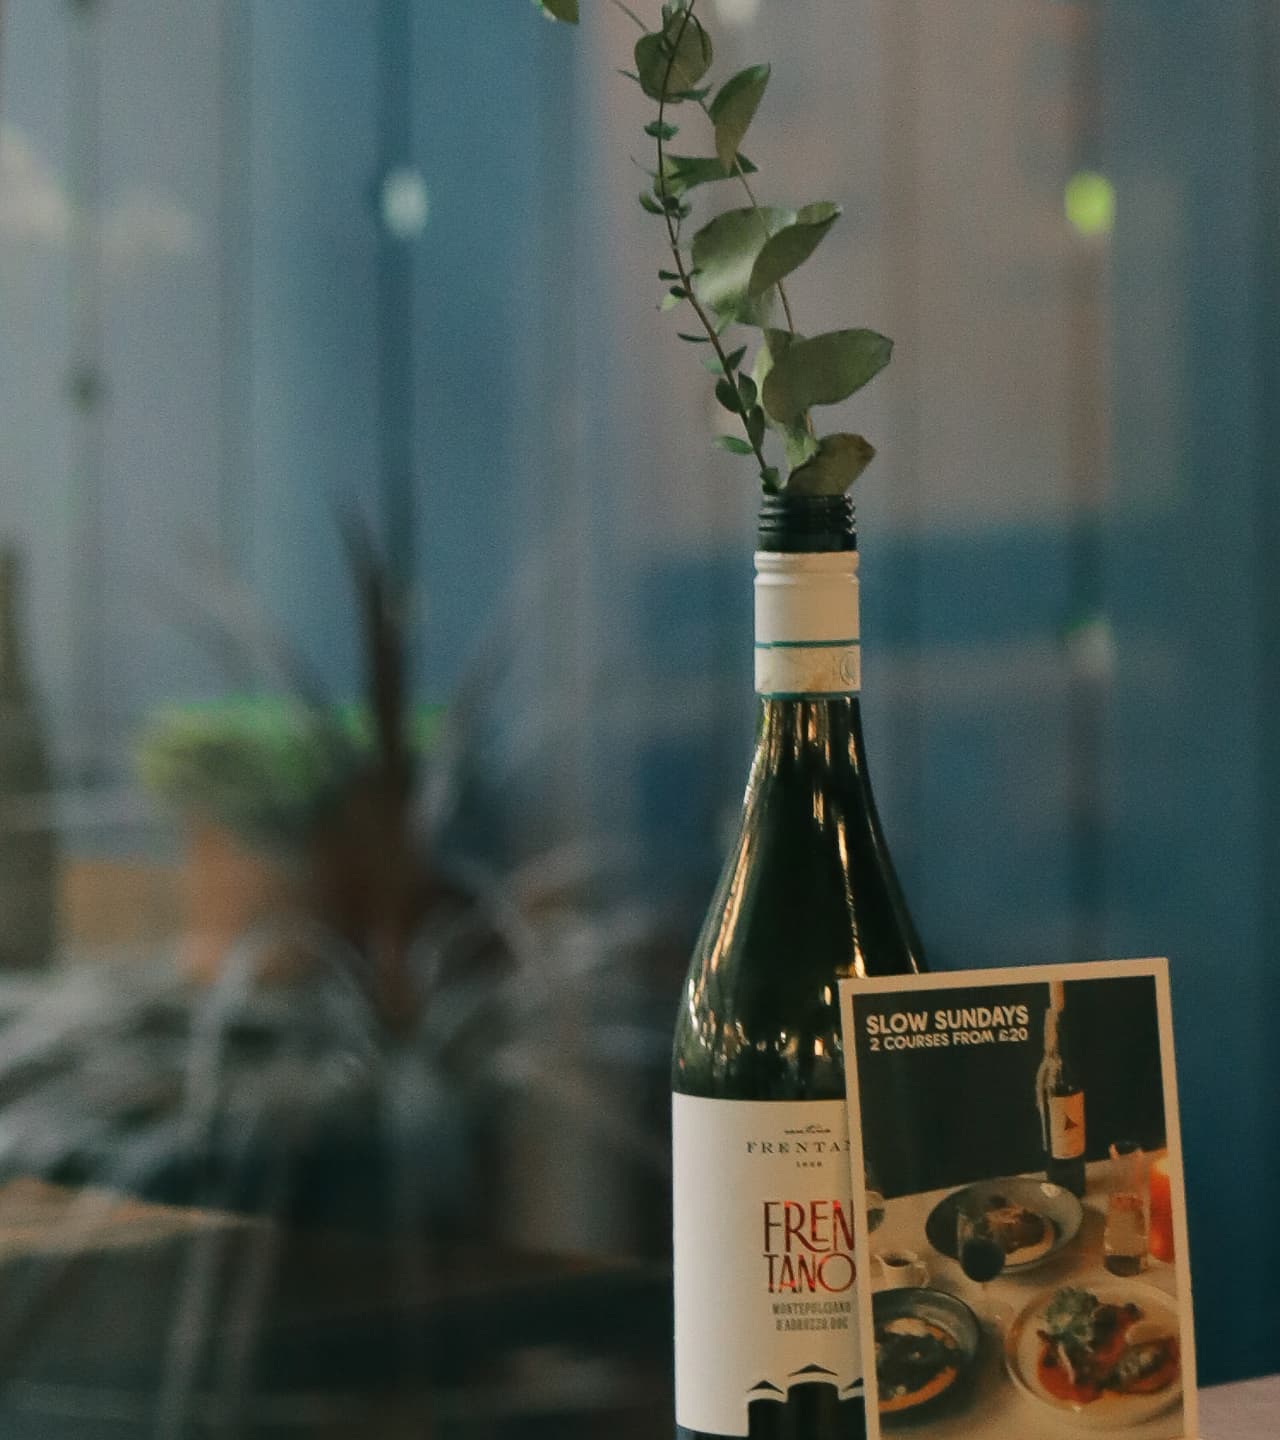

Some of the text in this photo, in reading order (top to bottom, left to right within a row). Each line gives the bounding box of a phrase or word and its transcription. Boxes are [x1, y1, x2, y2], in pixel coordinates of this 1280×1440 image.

[866, 1004, 1029, 1035] SLOW SUNDAYS
[870, 1027, 1028, 1051] 2 COURSES FROM £20
[763, 1200, 855, 1252] FREN
[763, 1253, 856, 1293] TANO
